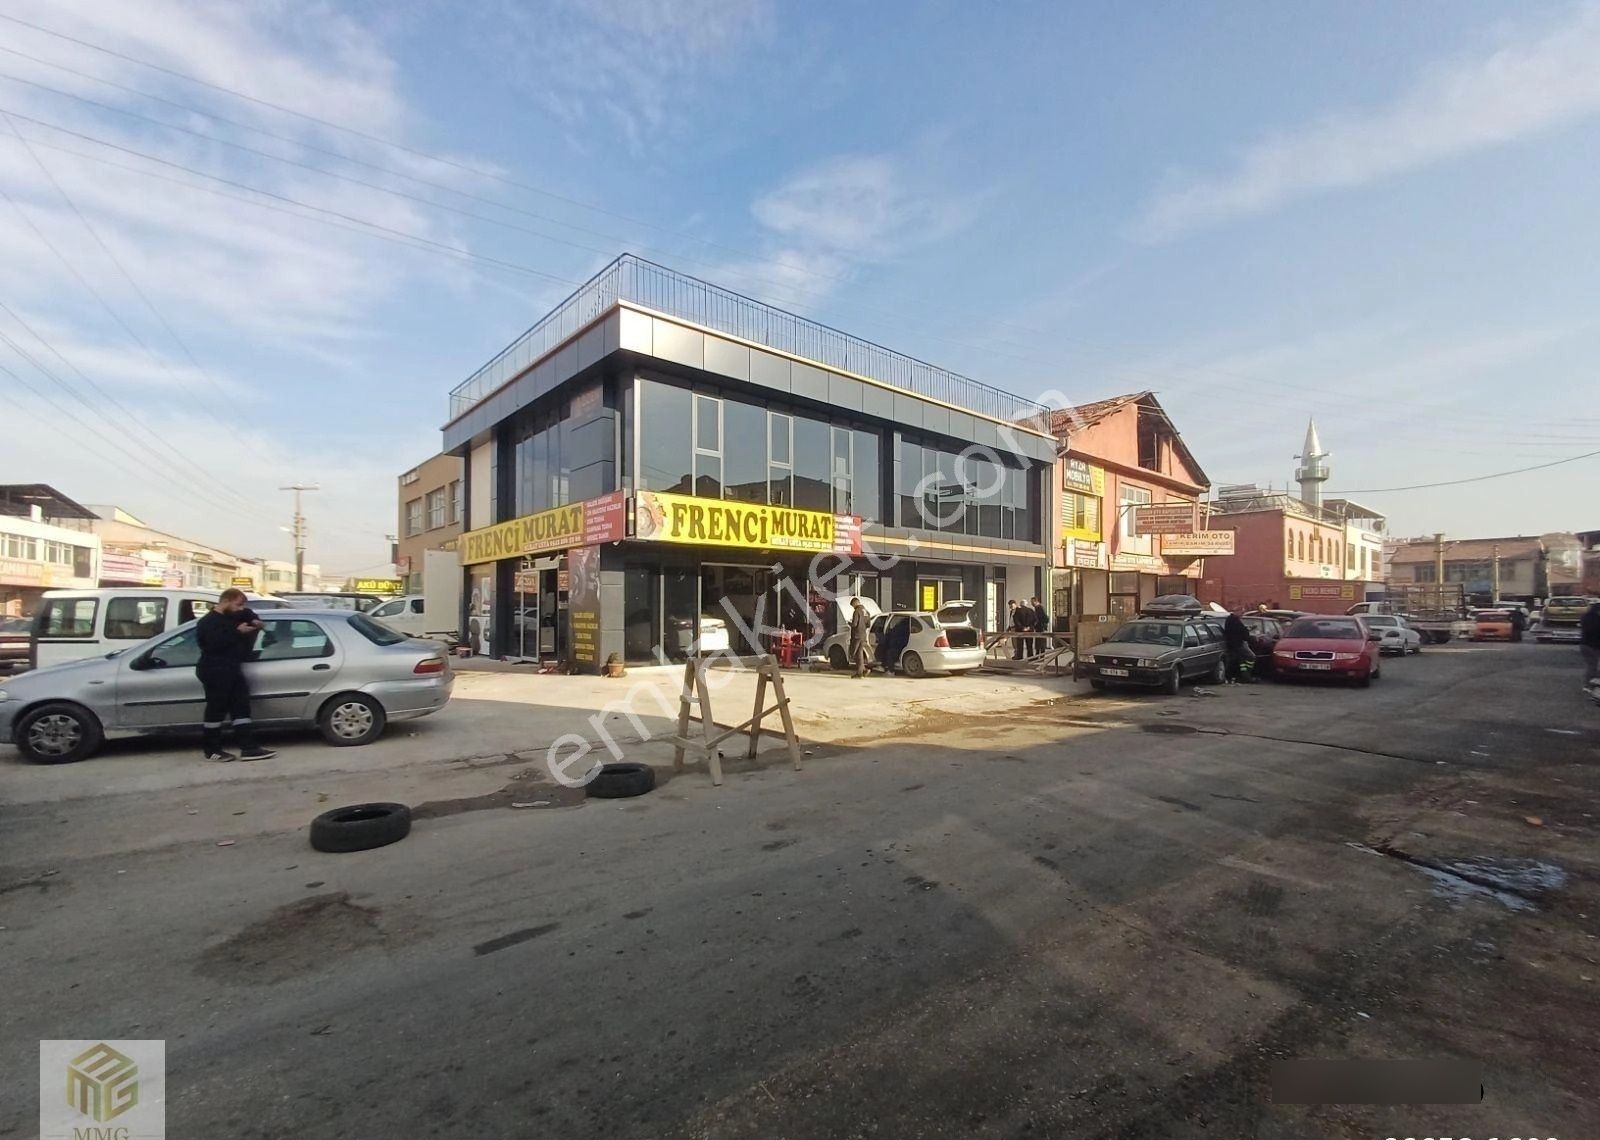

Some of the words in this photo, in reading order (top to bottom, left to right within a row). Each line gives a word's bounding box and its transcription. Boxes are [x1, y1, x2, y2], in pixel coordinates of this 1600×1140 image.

[522, 506, 582, 543] MURAT
[771, 510, 831, 540] MURAT
[1211, 532, 1230, 540] OTO
[356, 580, 377, 589] AKÜ
